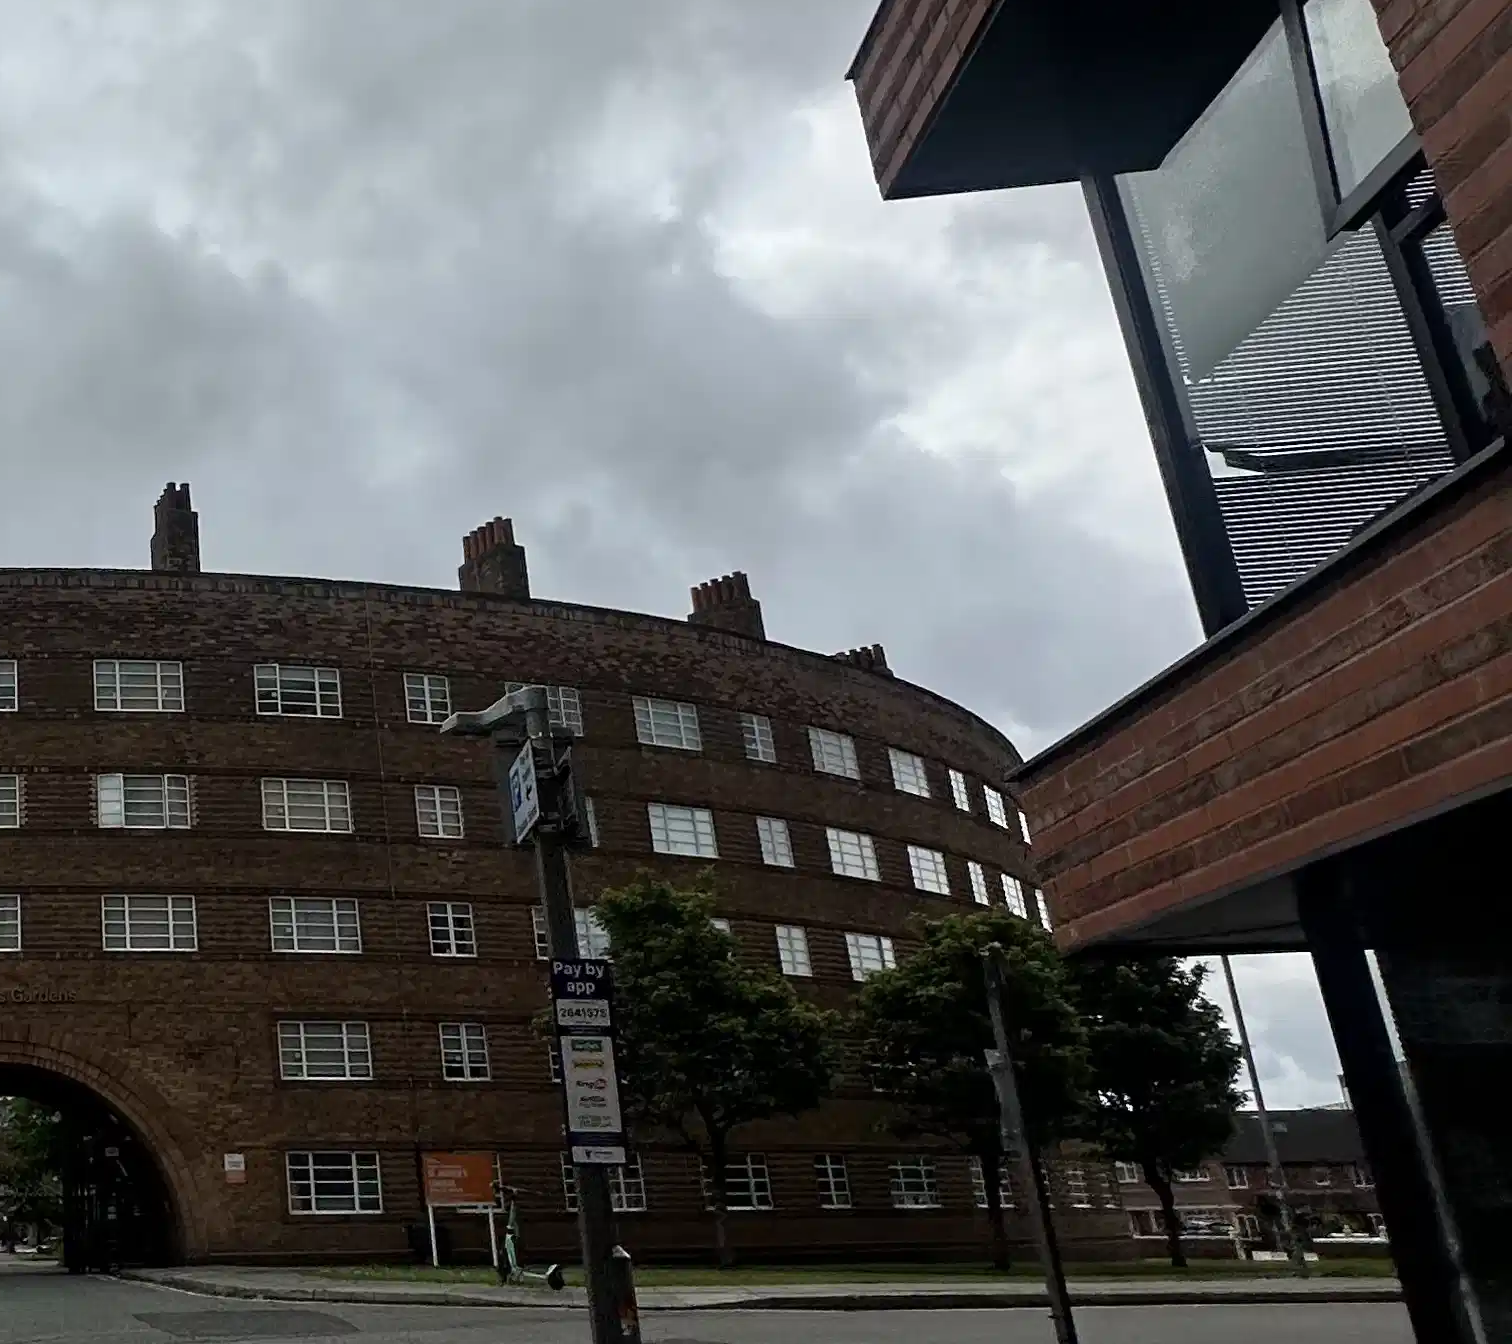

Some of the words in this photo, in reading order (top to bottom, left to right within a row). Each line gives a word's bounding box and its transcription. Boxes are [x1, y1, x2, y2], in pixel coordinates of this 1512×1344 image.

[552, 960, 582, 978] Pay
[584, 961, 605, 979] by
[11, 988, 78, 1004] Gardens
[566, 981, 596, 995] app
